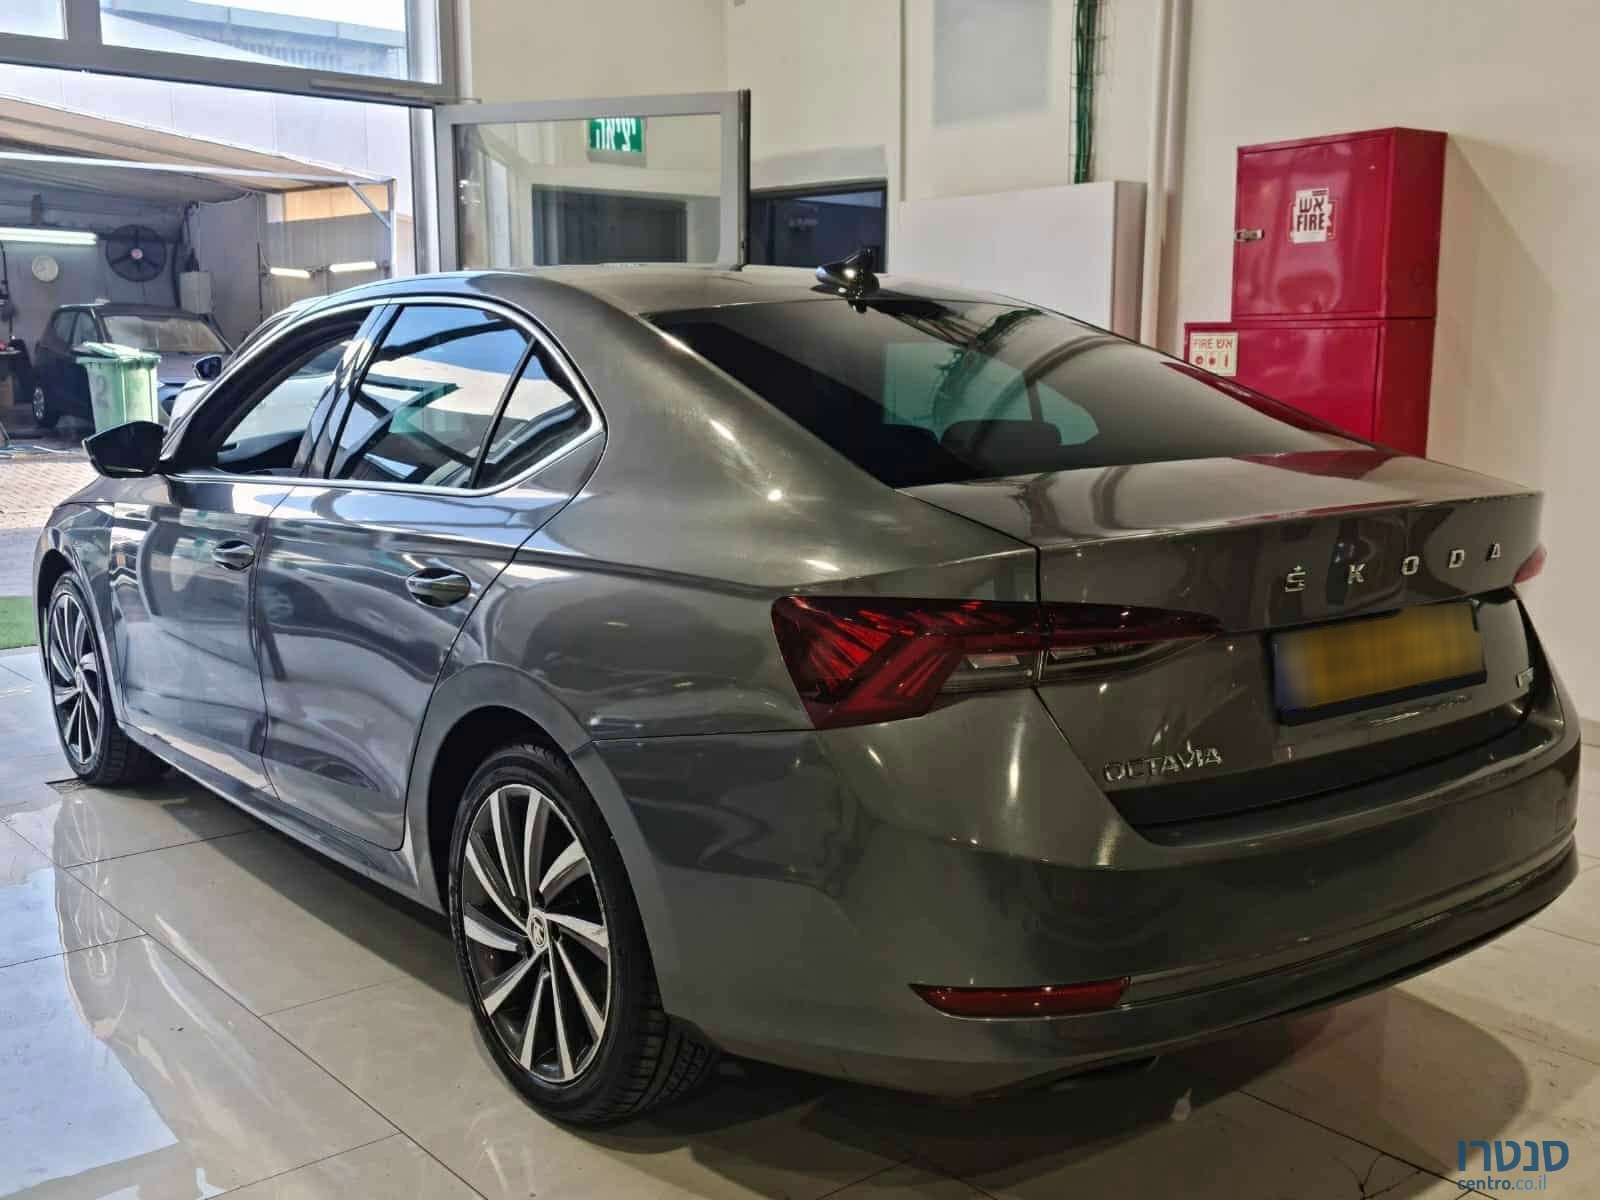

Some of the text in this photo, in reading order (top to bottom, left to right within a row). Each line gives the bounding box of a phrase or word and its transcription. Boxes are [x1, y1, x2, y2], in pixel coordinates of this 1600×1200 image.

[595, 117, 636, 151] יציאה
[1299, 197, 1325, 213] אש
[1297, 213, 1325, 232] FIRE
[1104, 746, 1222, 781] OCTAVIA
